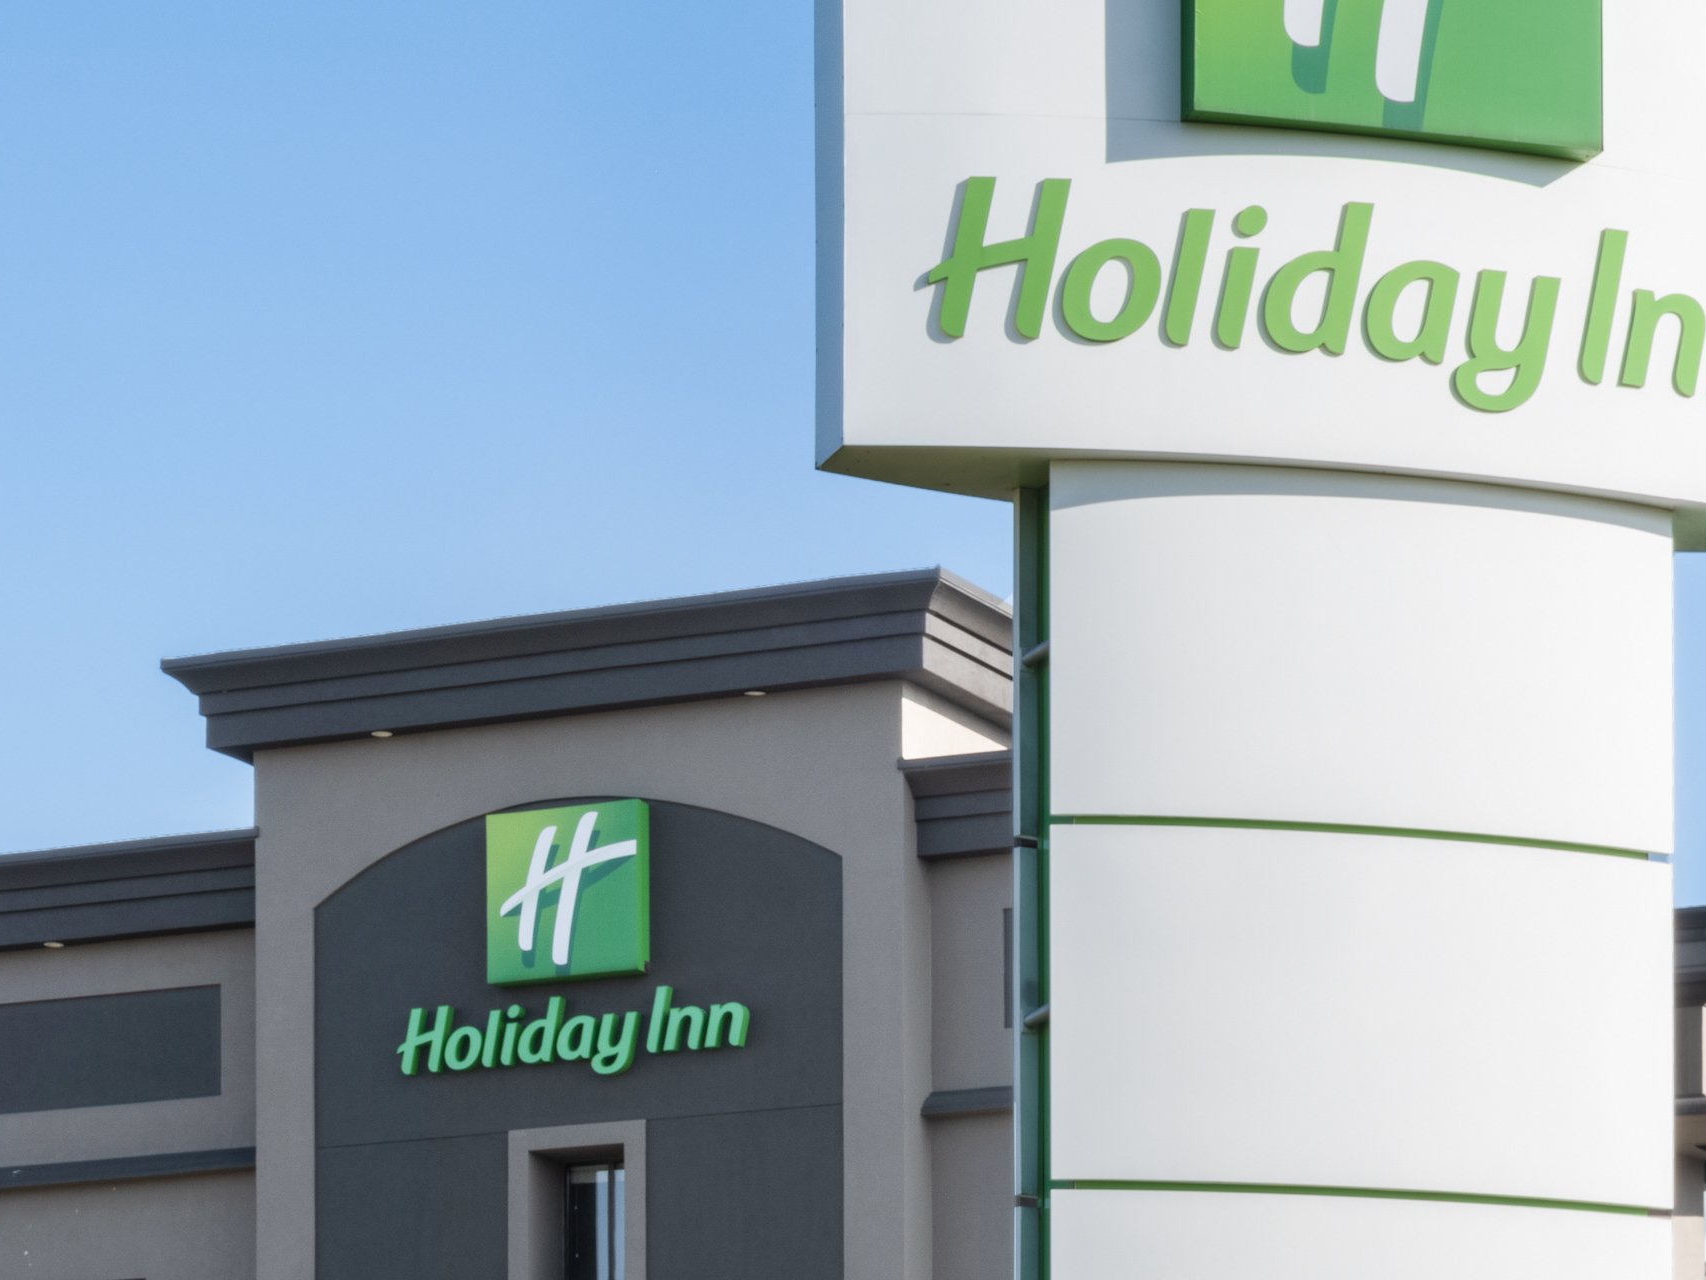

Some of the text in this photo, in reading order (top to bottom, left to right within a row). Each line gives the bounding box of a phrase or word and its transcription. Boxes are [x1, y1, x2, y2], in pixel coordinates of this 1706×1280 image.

[927, 175, 1561, 413] Holiday
[395, 984, 751, 1076] Holiday Inn
